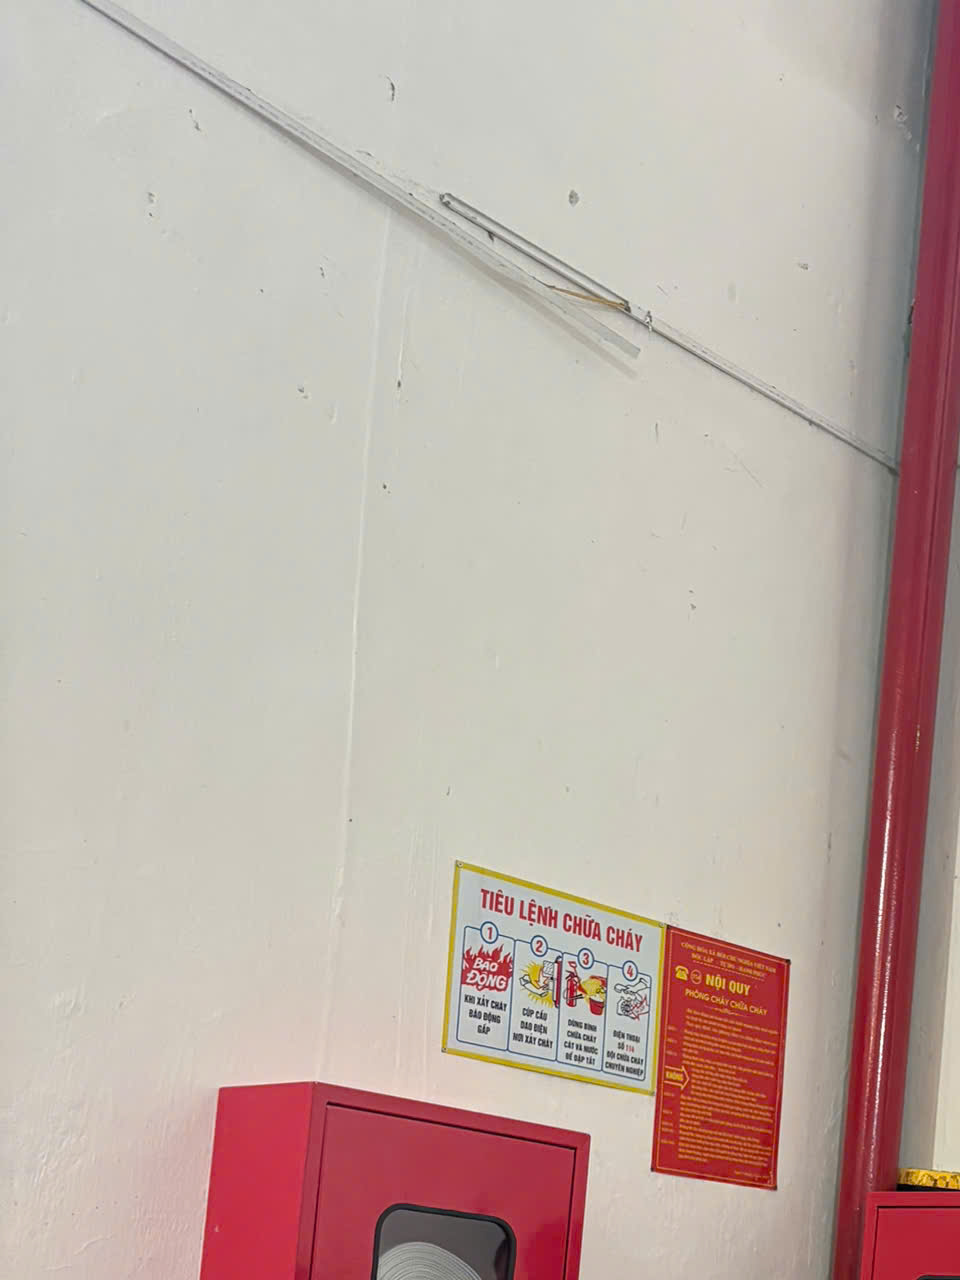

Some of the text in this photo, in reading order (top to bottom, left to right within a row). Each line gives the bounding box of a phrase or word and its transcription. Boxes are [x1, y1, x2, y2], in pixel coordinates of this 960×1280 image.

[480, 888, 643, 953] TIÊU LỆNH CHỮA CHÁY
[487, 927, 493, 940] 1
[535, 940, 544, 953] 2
[582, 953, 590, 966] 3
[466, 970, 507, 990] ĐỘNG
[626, 965, 634, 978] 4
[705, 974, 751, 996] NỘI QUY
[464, 994, 476, 1004] KHI
[490, 1000, 507, 1012] CHÁY
[684, 988, 710, 1002] PHÒNG
[710, 994, 730, 1006] CHÁY
[749, 1005, 768, 1016] CHÁY
